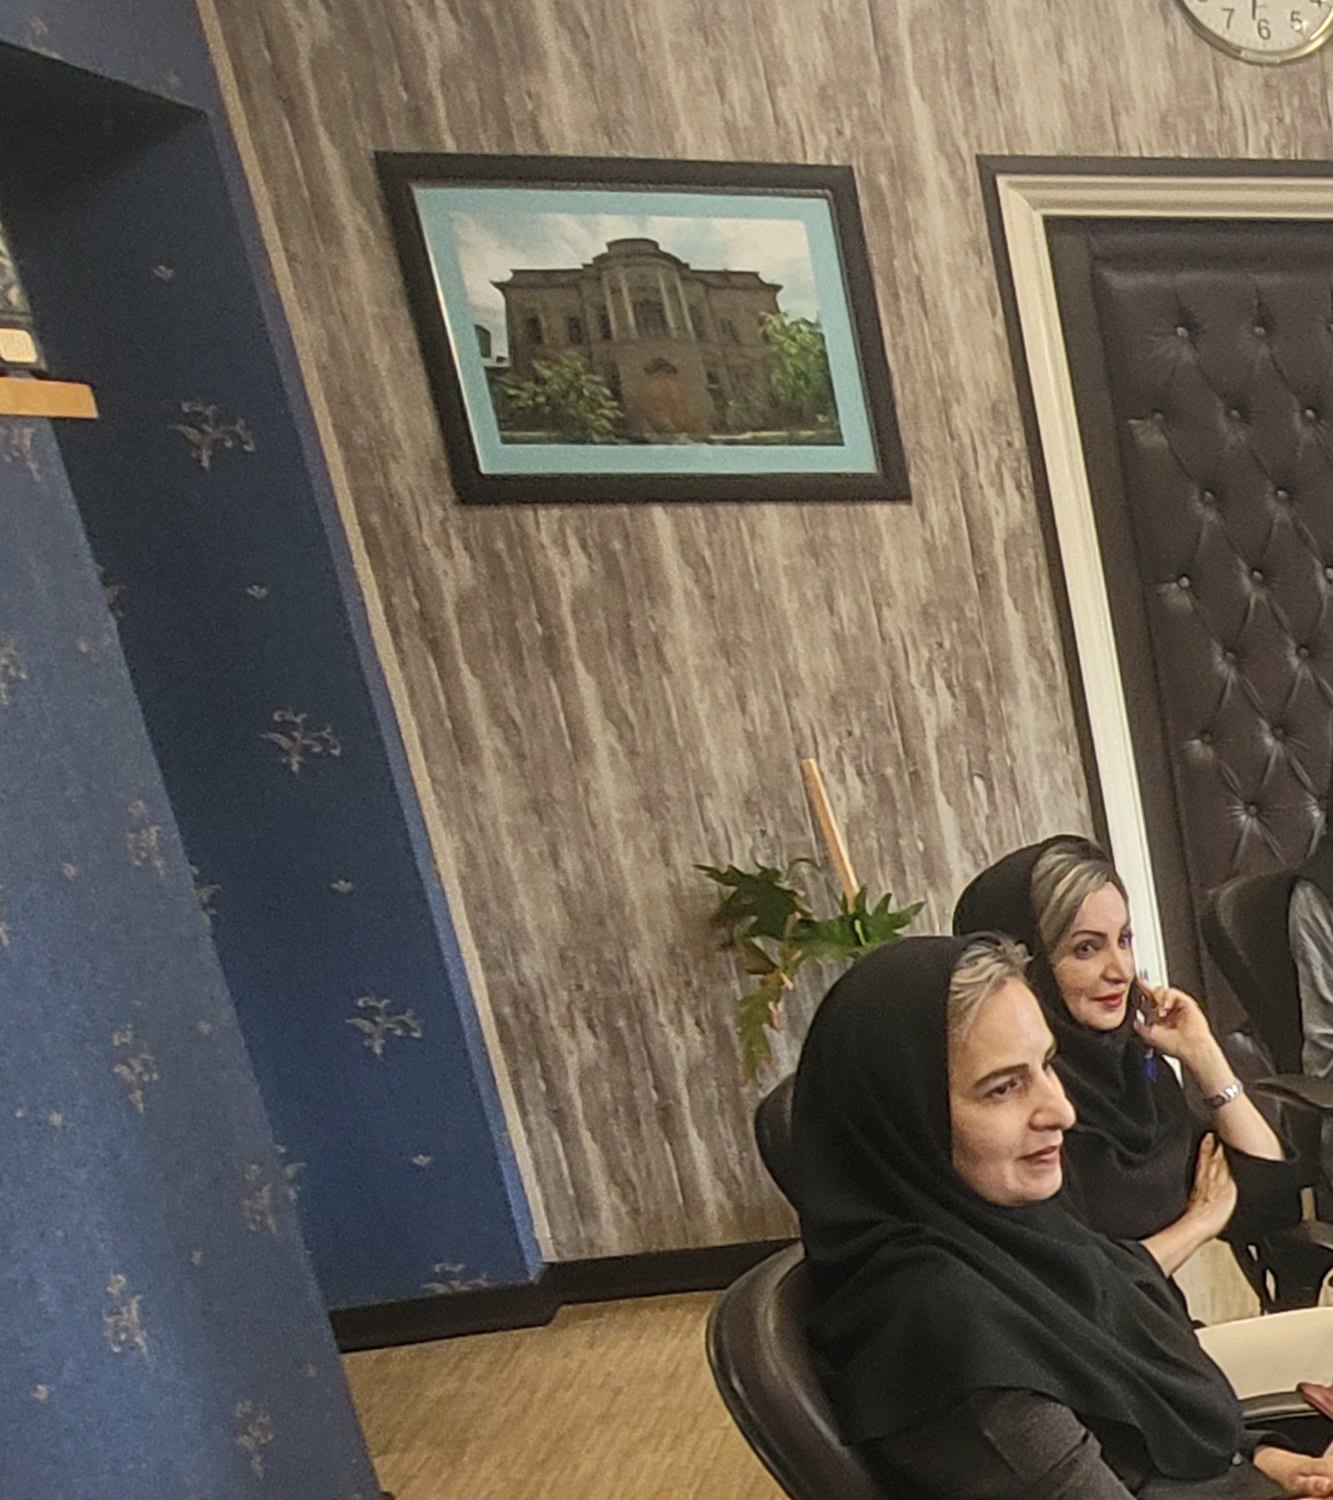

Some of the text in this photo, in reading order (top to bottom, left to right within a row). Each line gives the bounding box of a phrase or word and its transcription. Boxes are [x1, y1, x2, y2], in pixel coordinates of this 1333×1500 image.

[1221, 7, 1235, 30] 7
[1257, 18, 1272, 40] 6
[1289, 10, 1304, 33] 5
